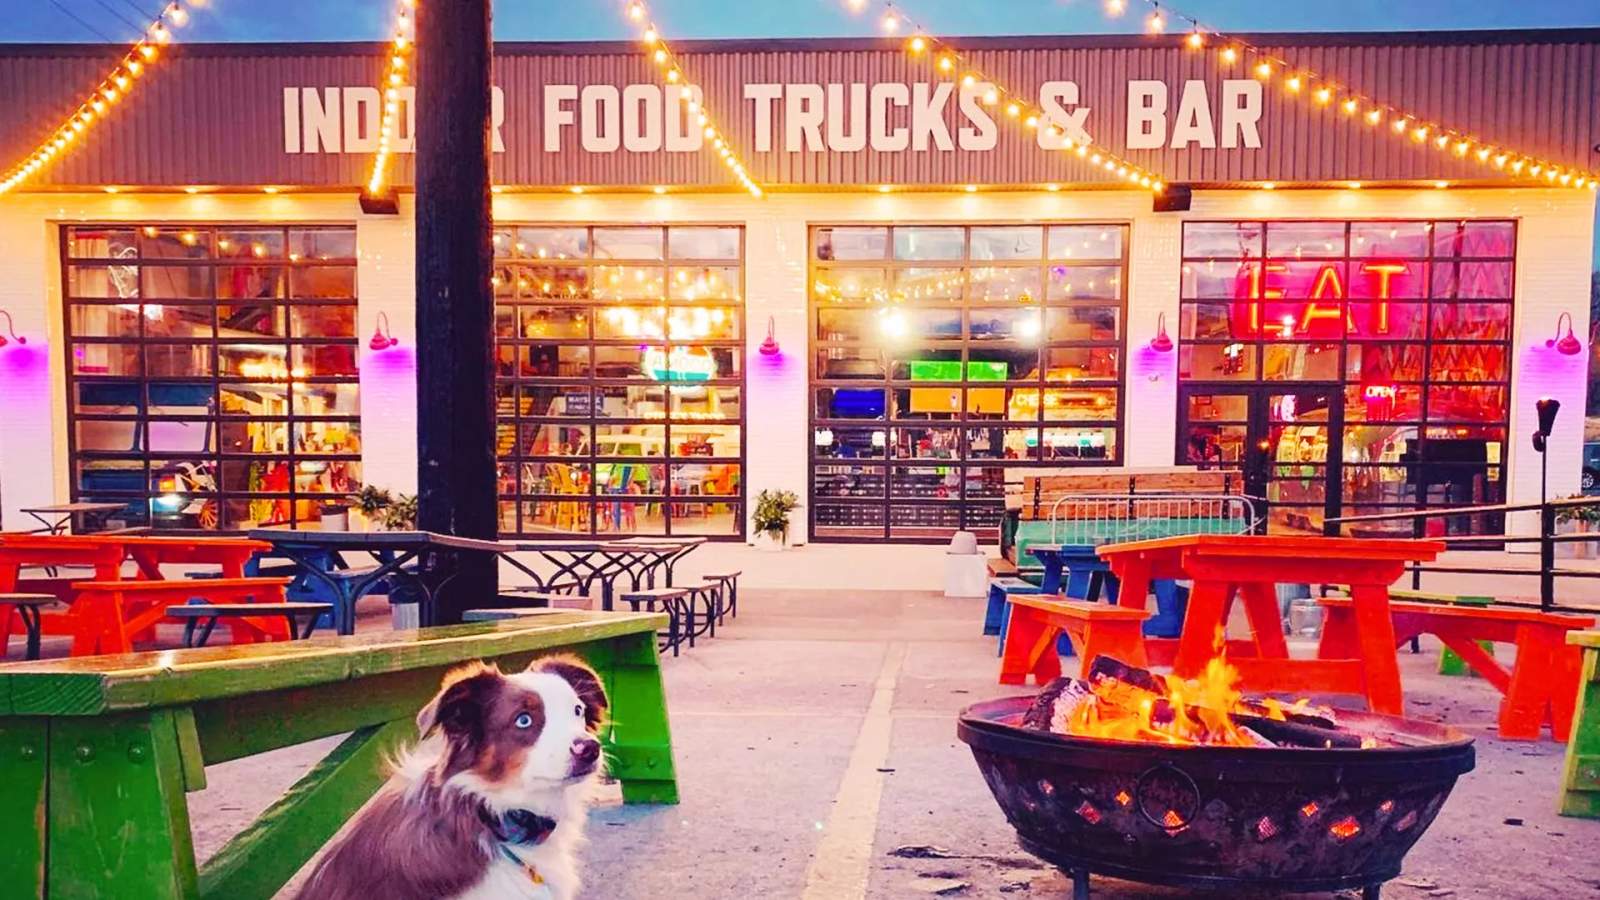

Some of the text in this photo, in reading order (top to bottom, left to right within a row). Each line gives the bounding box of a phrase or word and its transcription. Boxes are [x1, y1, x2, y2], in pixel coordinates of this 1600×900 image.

[284, 79, 1263, 153] INDO FOOD TRUCKS & BAR
[1248, 263, 1410, 333] EAT
[1366, 385, 1397, 398] OPEN
